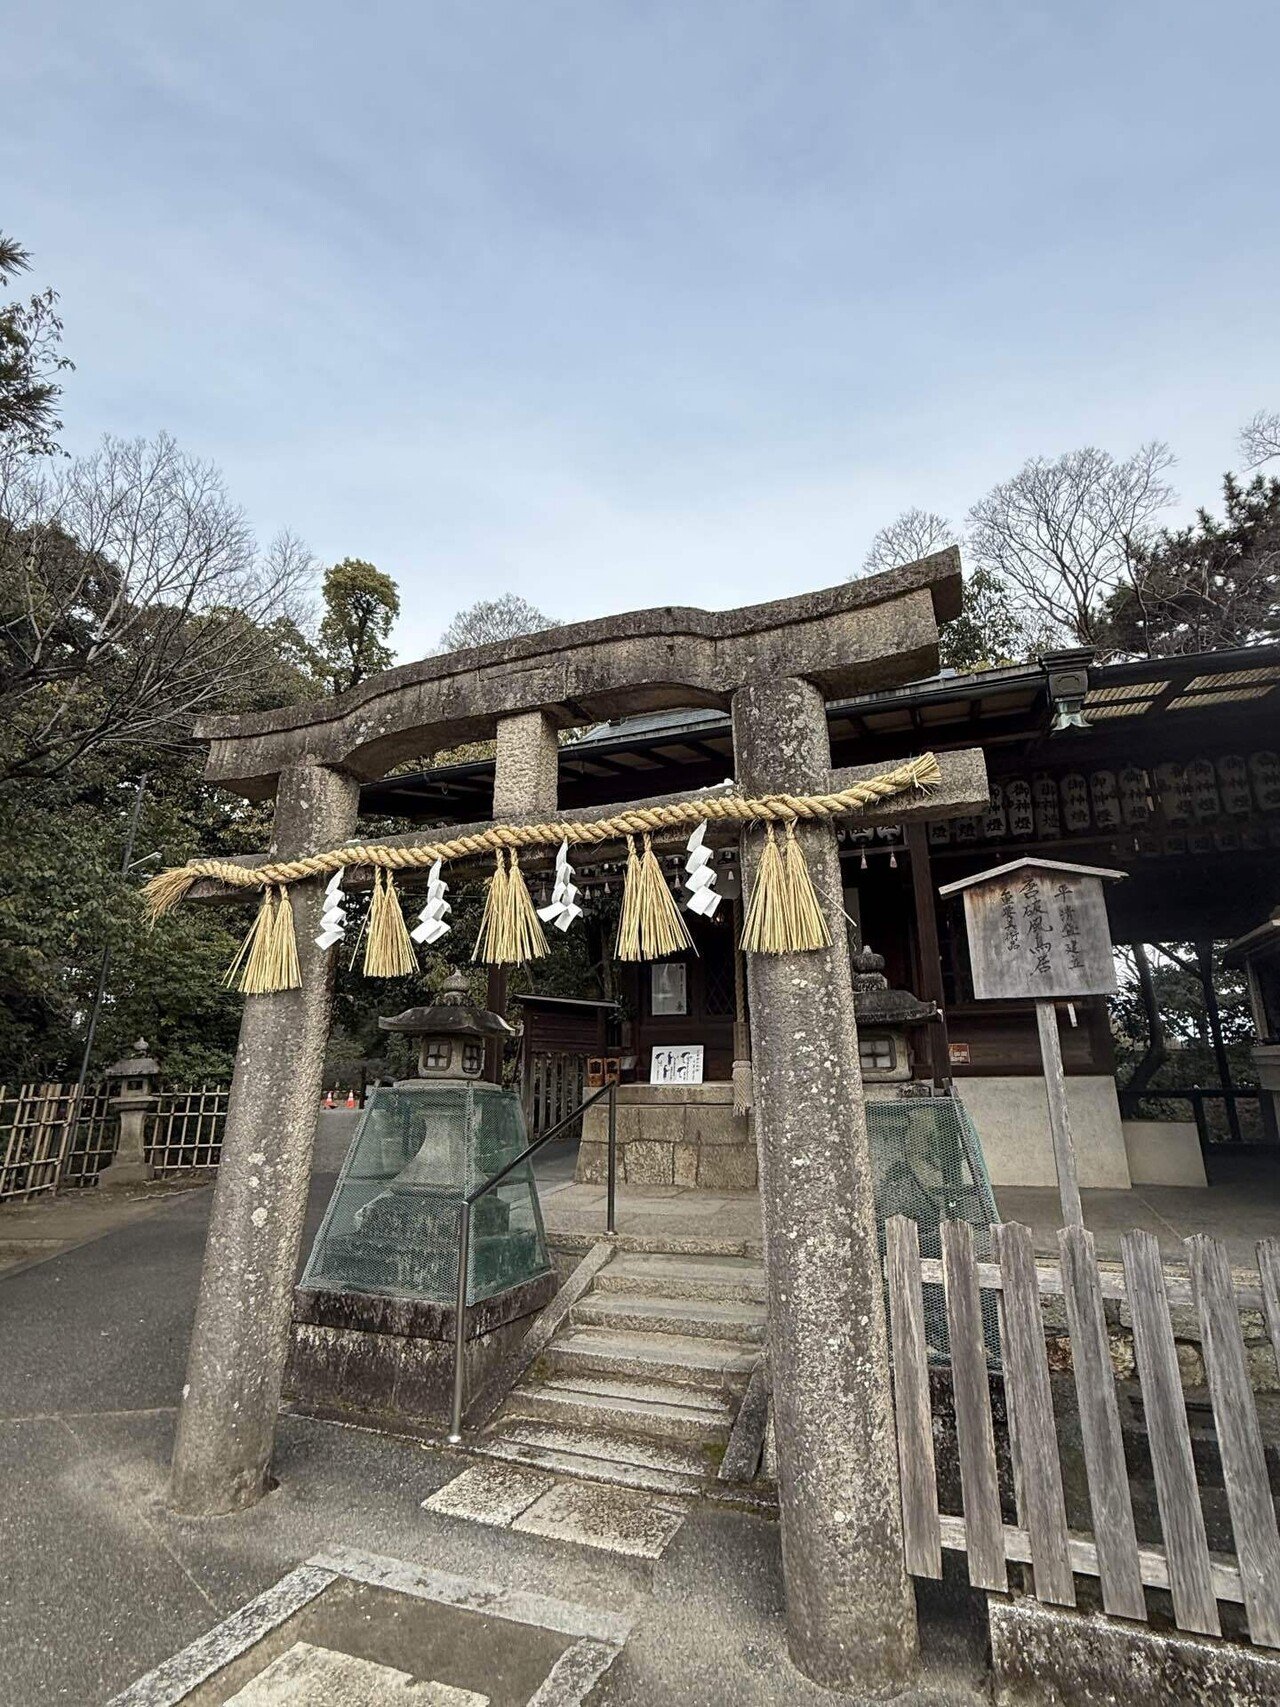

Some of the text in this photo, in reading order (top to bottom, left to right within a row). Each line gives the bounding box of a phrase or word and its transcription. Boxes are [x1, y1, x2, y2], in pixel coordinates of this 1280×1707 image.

[1012, 783, 1032, 830] 御神燈
[1019, 874, 1053, 976] 唐破風鳥居
[1054, 883, 1085, 970] 平清盛建立
